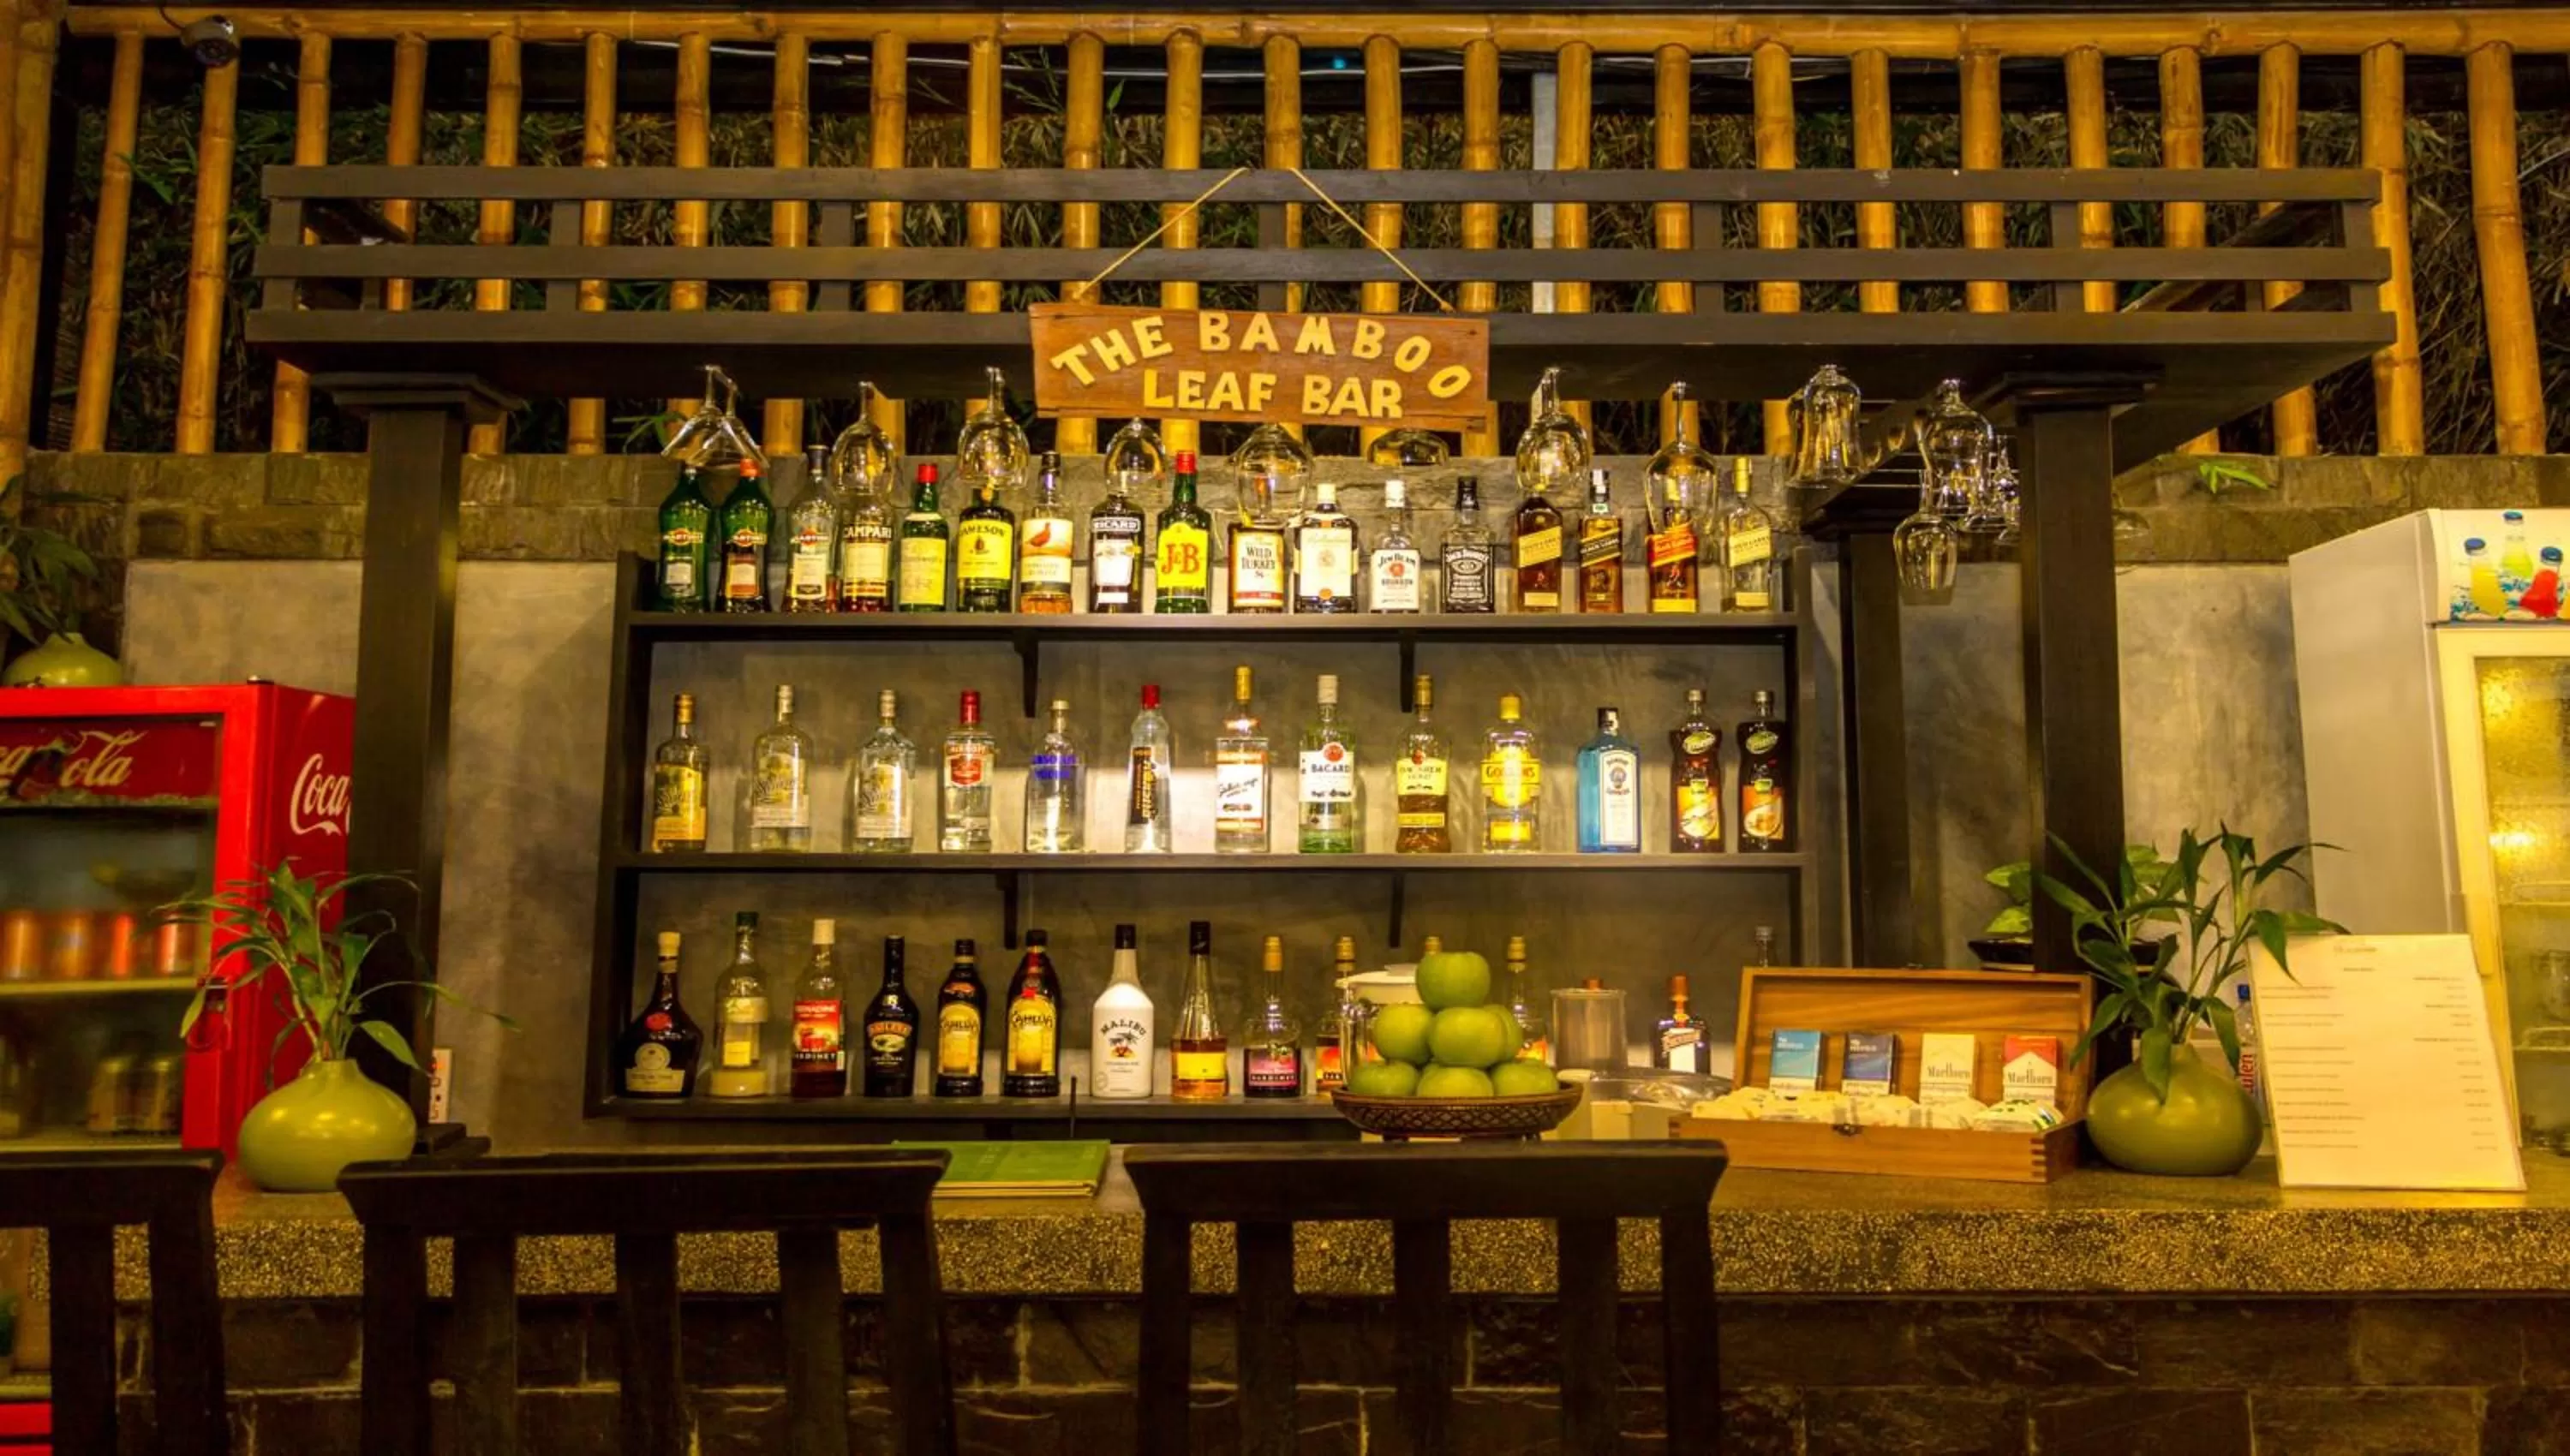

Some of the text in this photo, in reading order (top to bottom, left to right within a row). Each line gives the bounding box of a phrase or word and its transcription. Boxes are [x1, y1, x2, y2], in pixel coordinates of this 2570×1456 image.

[1050, 312, 1472, 399] THE BAMBOO
[1144, 368, 1404, 419] LEAF BAR
[843, 525, 892, 539] CAMPARI
[1100, 1018, 1148, 1036] MALIBU
